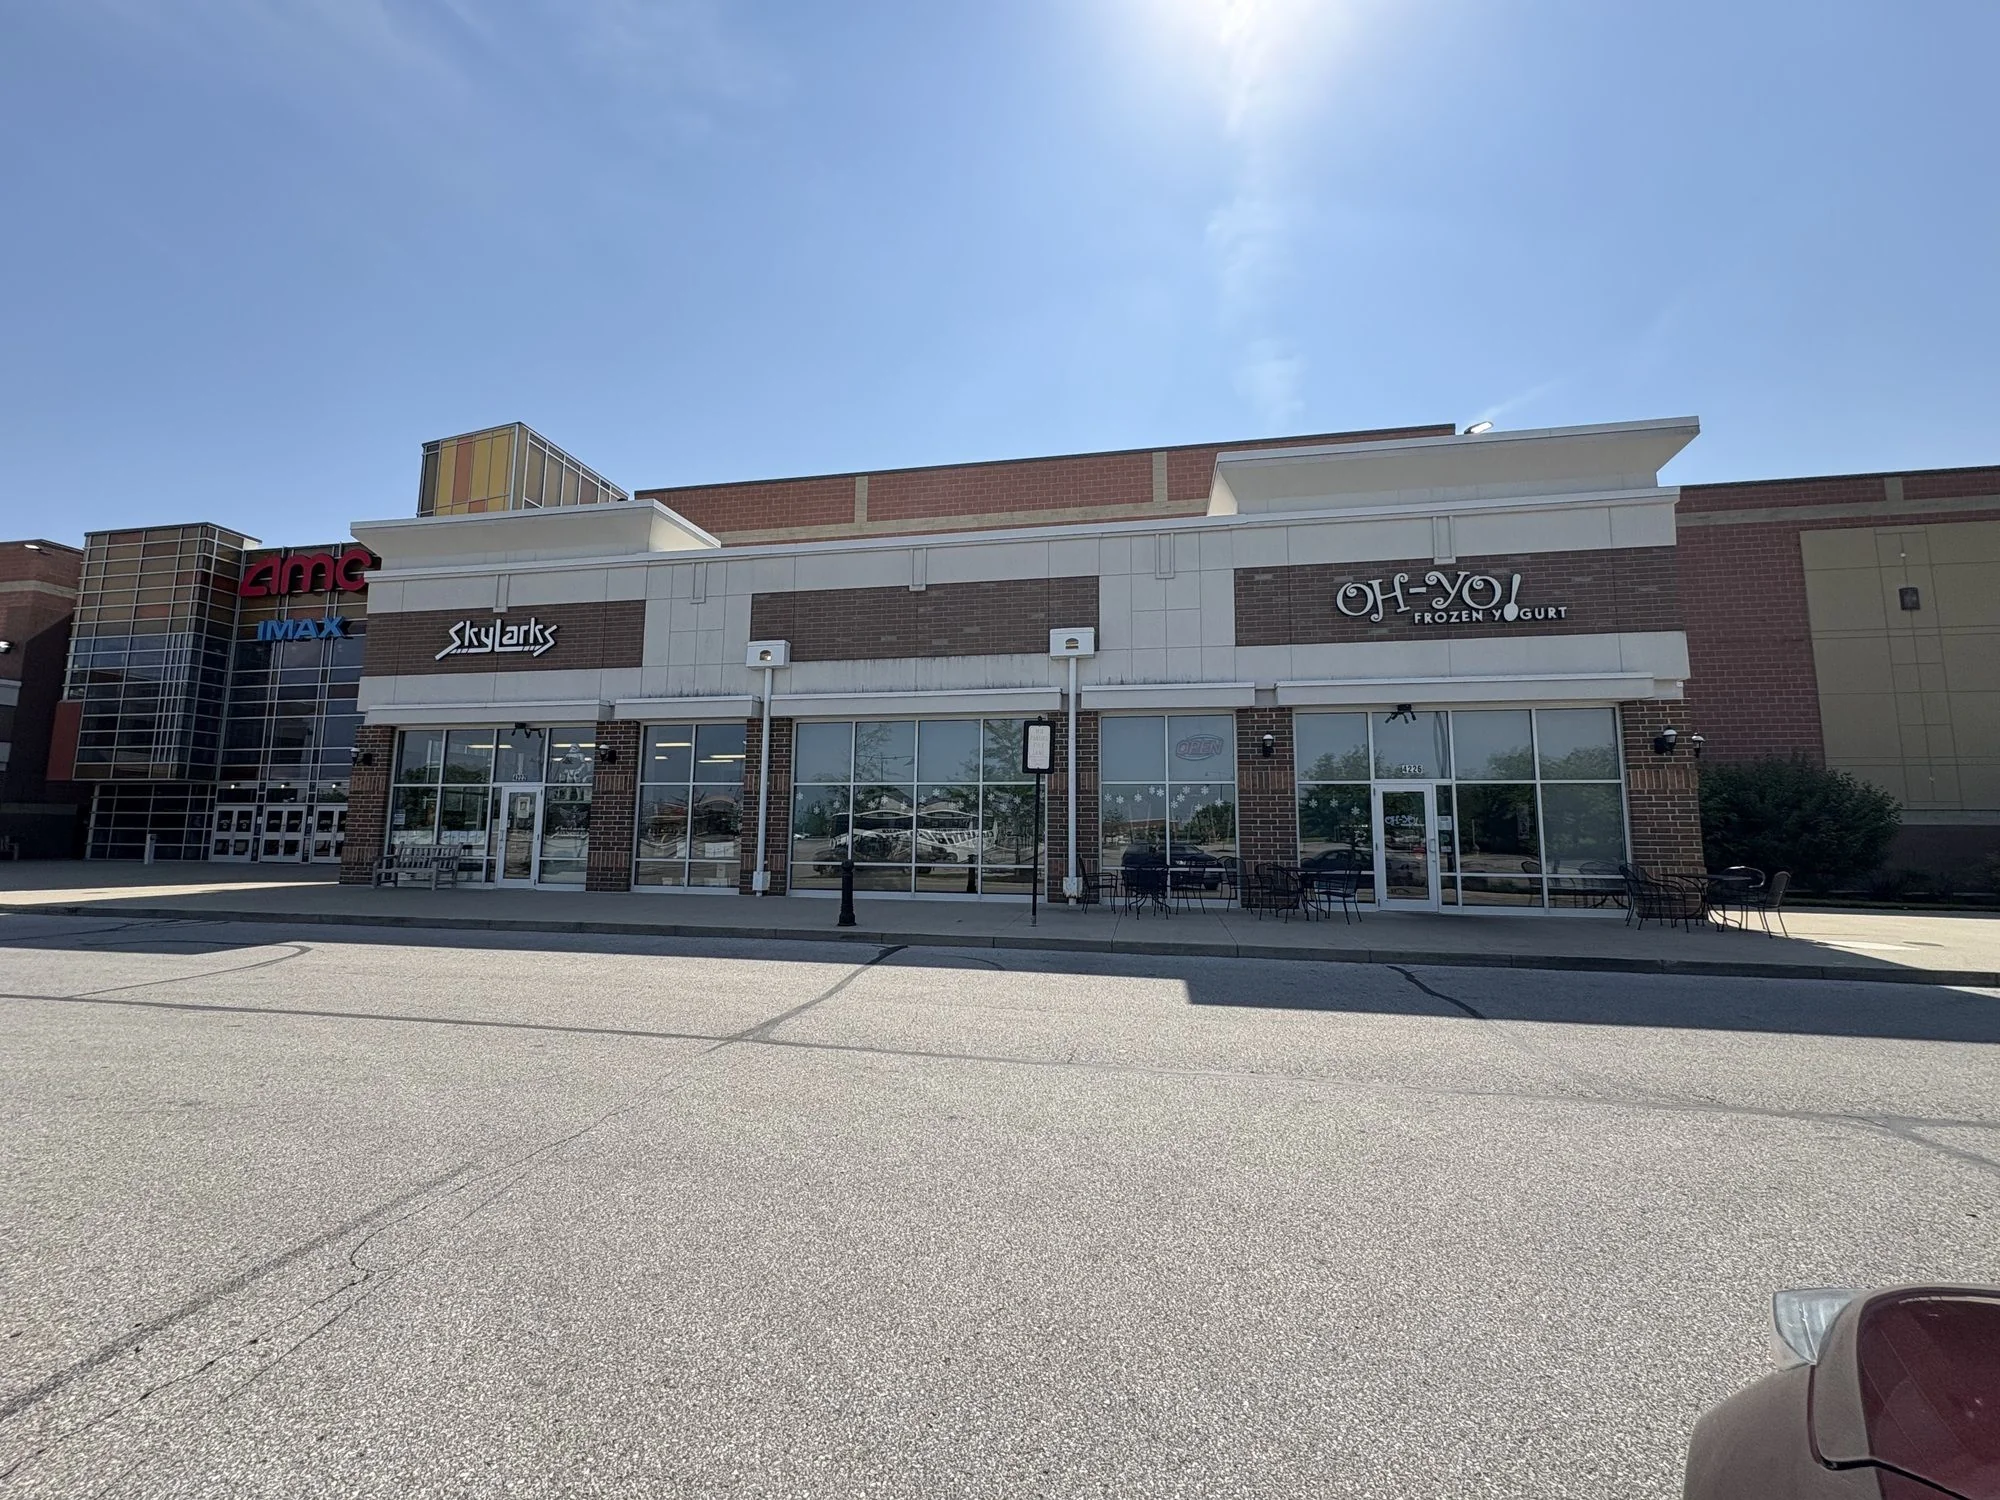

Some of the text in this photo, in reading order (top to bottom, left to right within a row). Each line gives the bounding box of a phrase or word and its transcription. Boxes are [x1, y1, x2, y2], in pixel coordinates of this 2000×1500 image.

[1414, 609, 1484, 624] FROZEN
[257, 615, 345, 641] IMAX
[1177, 740, 1223, 755] OPEN
